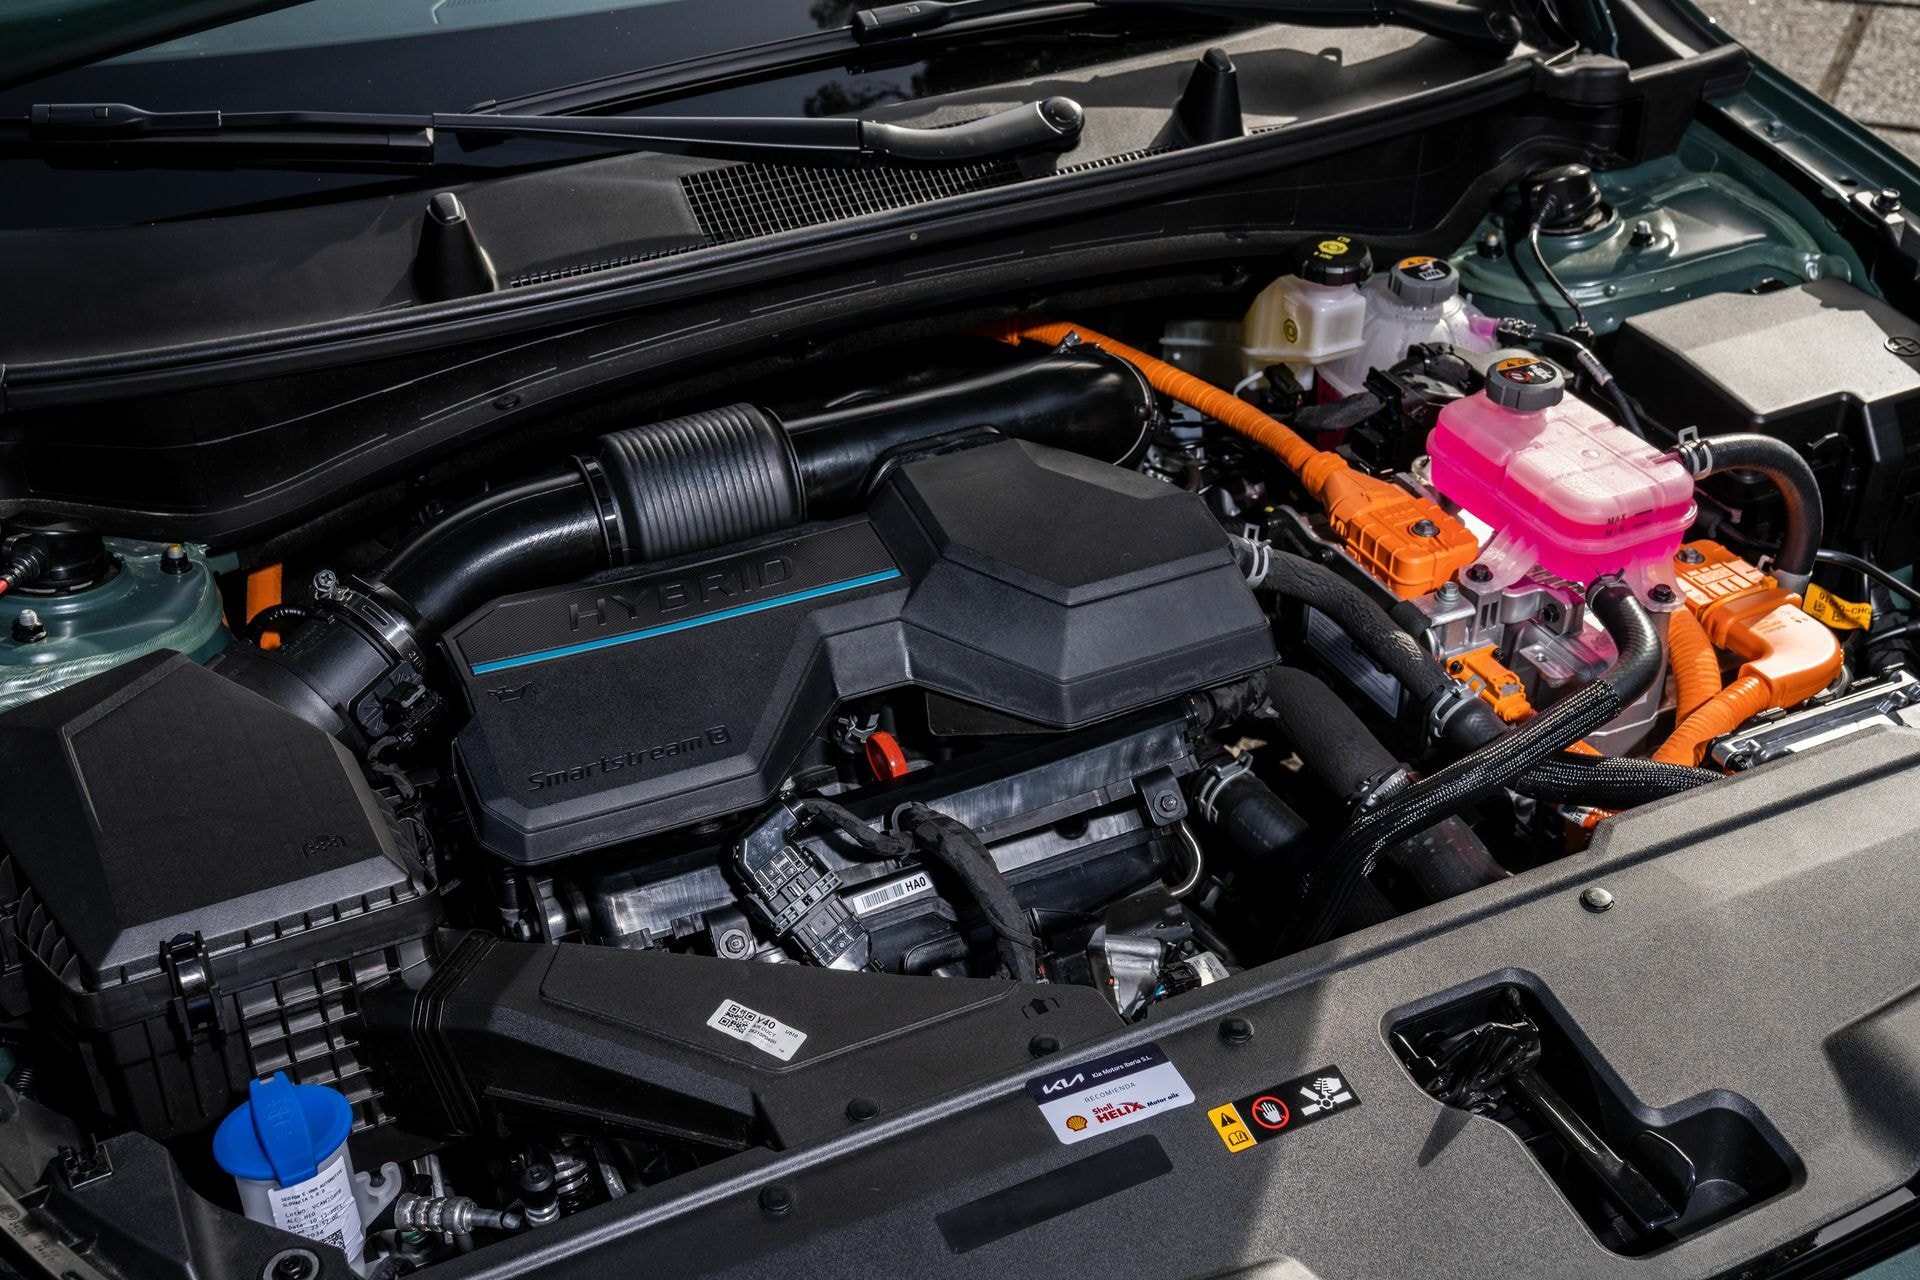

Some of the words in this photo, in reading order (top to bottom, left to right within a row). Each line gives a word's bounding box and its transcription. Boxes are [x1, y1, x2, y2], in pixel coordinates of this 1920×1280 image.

[1607, 513, 1626, 524] MAX
[569, 555, 794, 632] HYBRID
[527, 735, 704, 792] Smartstream
[757, 1016, 776, 1030] Y40
[761, 1026, 777, 1037] DUCT
[1102, 1065, 1125, 1075] Motors
[1124, 1059, 1142, 1068] Iberia
[1084, 1082, 1136, 1103] RECOMIENDA
[1092, 1103, 1114, 1115] Shell
[1096, 1101, 1147, 1124] HELIX
[1147, 1098, 1167, 1108] Motor
[319, 1169, 343, 1189] AUTOMOTIVE
